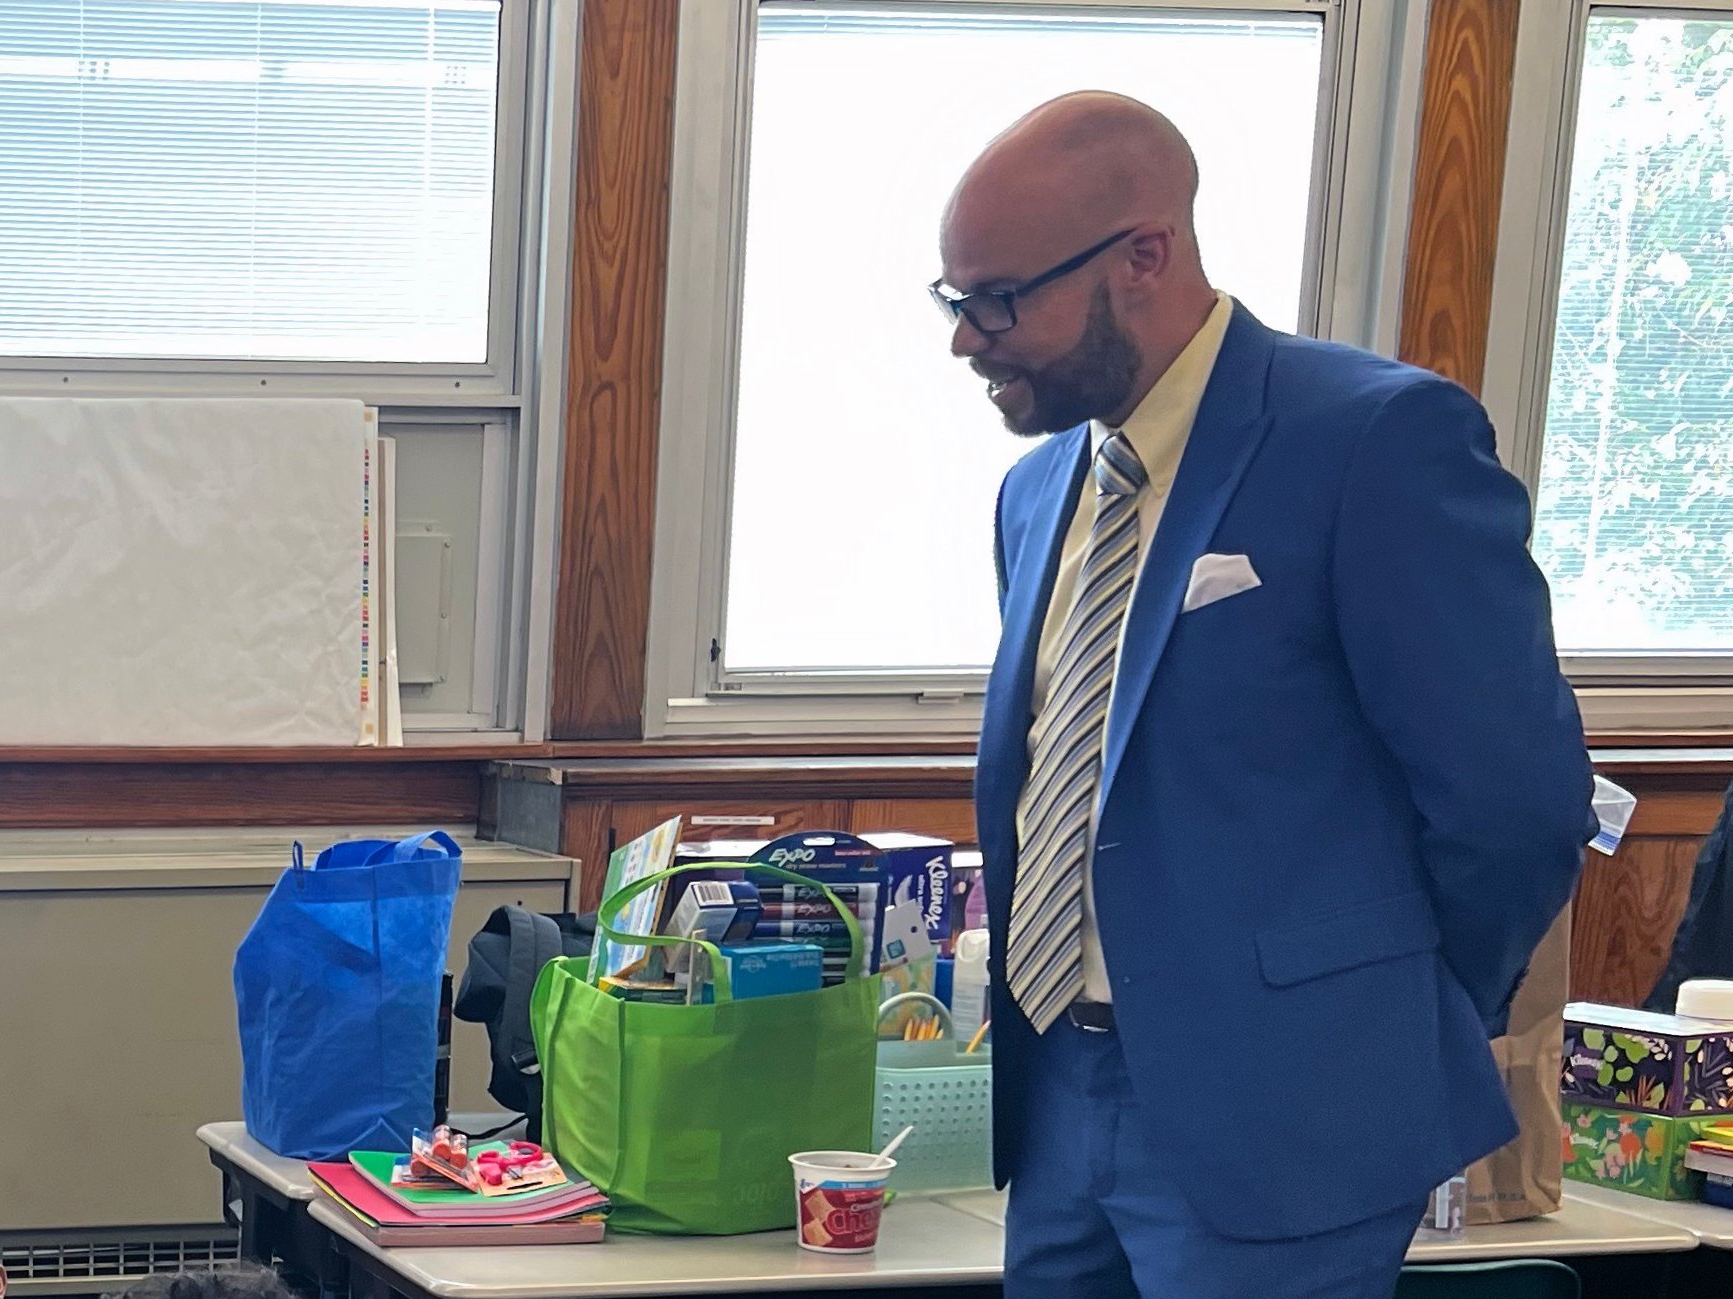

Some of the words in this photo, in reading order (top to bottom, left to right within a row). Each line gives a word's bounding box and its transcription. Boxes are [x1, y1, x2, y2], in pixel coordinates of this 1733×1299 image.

[769, 848, 816, 867] EXPO
[925, 855, 948, 930] Kleenex
[797, 903, 832, 916] EXPO
[796, 922, 831, 934] EXPO
[825, 1207, 879, 1236] Che
